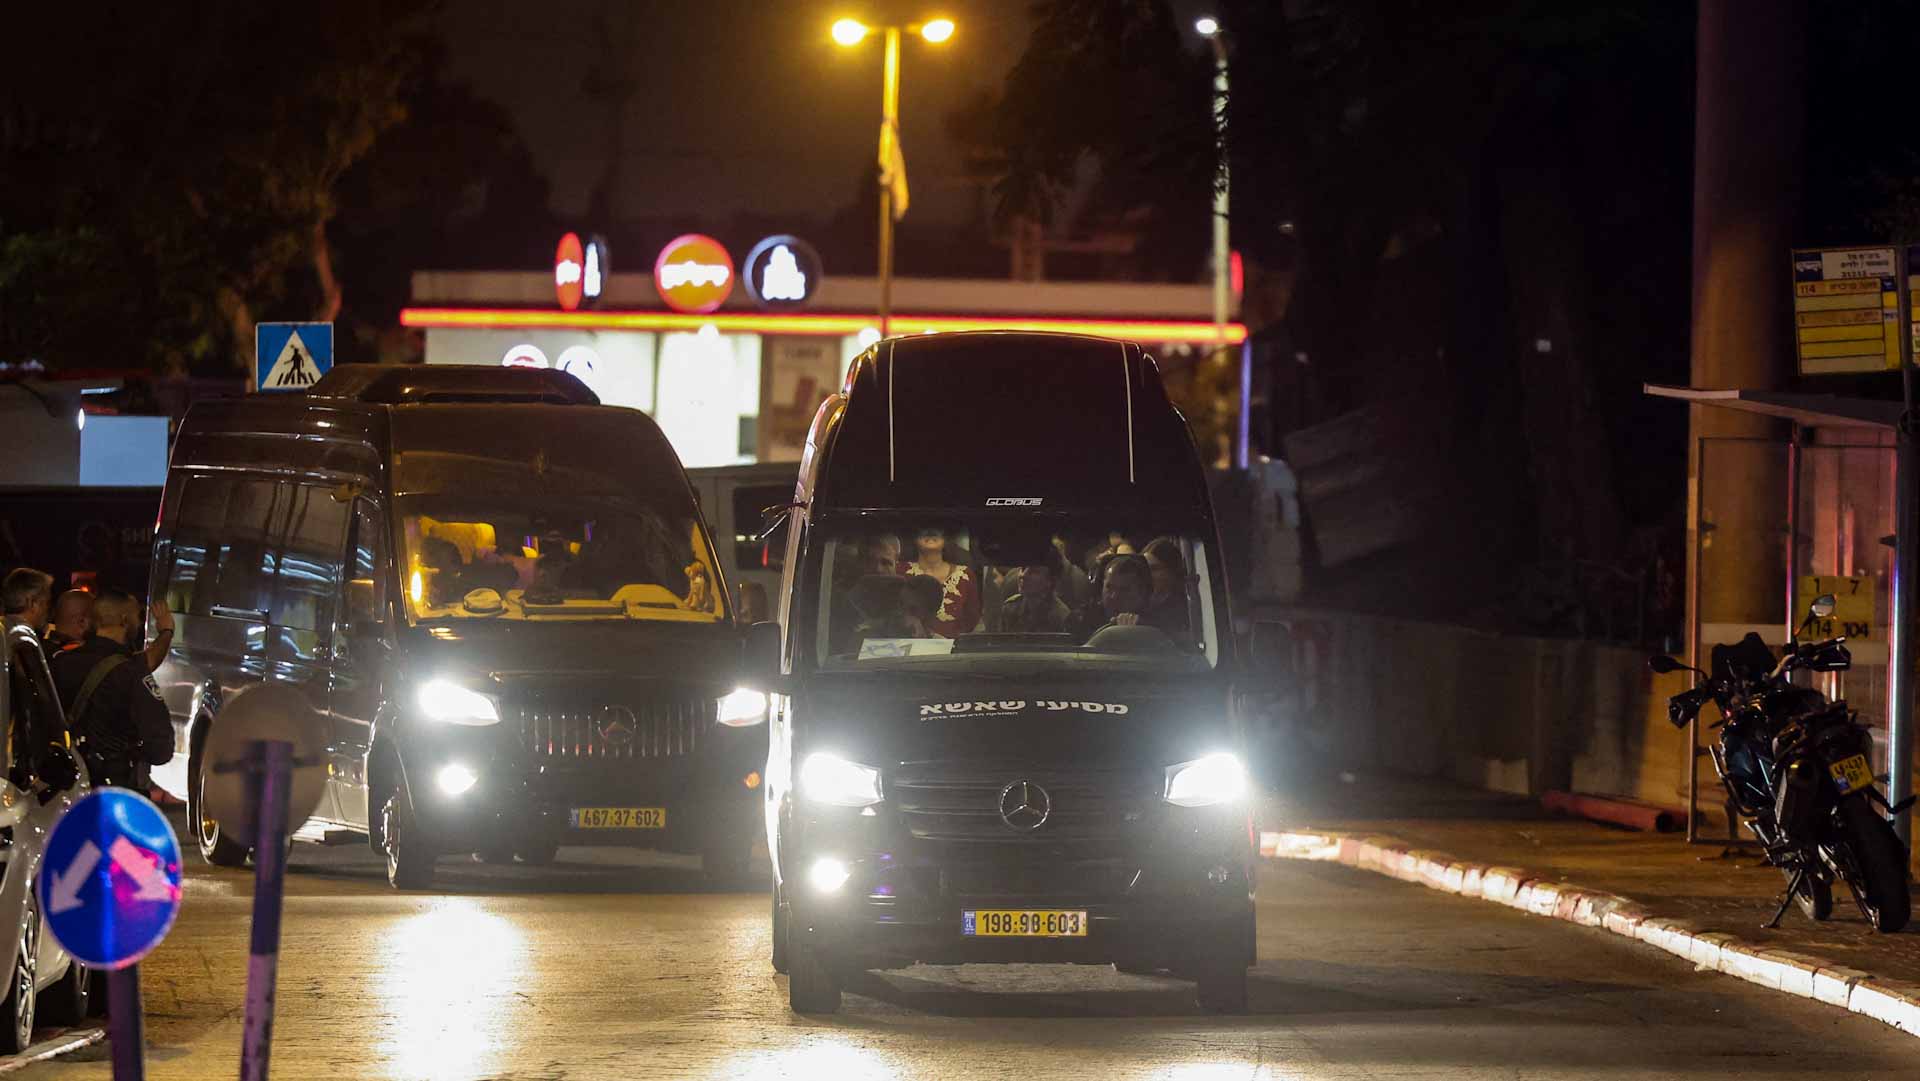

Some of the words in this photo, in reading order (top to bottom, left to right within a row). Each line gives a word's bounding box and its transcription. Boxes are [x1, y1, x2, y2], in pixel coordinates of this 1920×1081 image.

[1800, 284, 1816, 294] 114
[985, 497, 1044, 506] GLOBUS
[1849, 579, 1860, 595] 7
[919, 700, 1026, 715] שאשא
[1035, 700, 1130, 715] מסיעי
